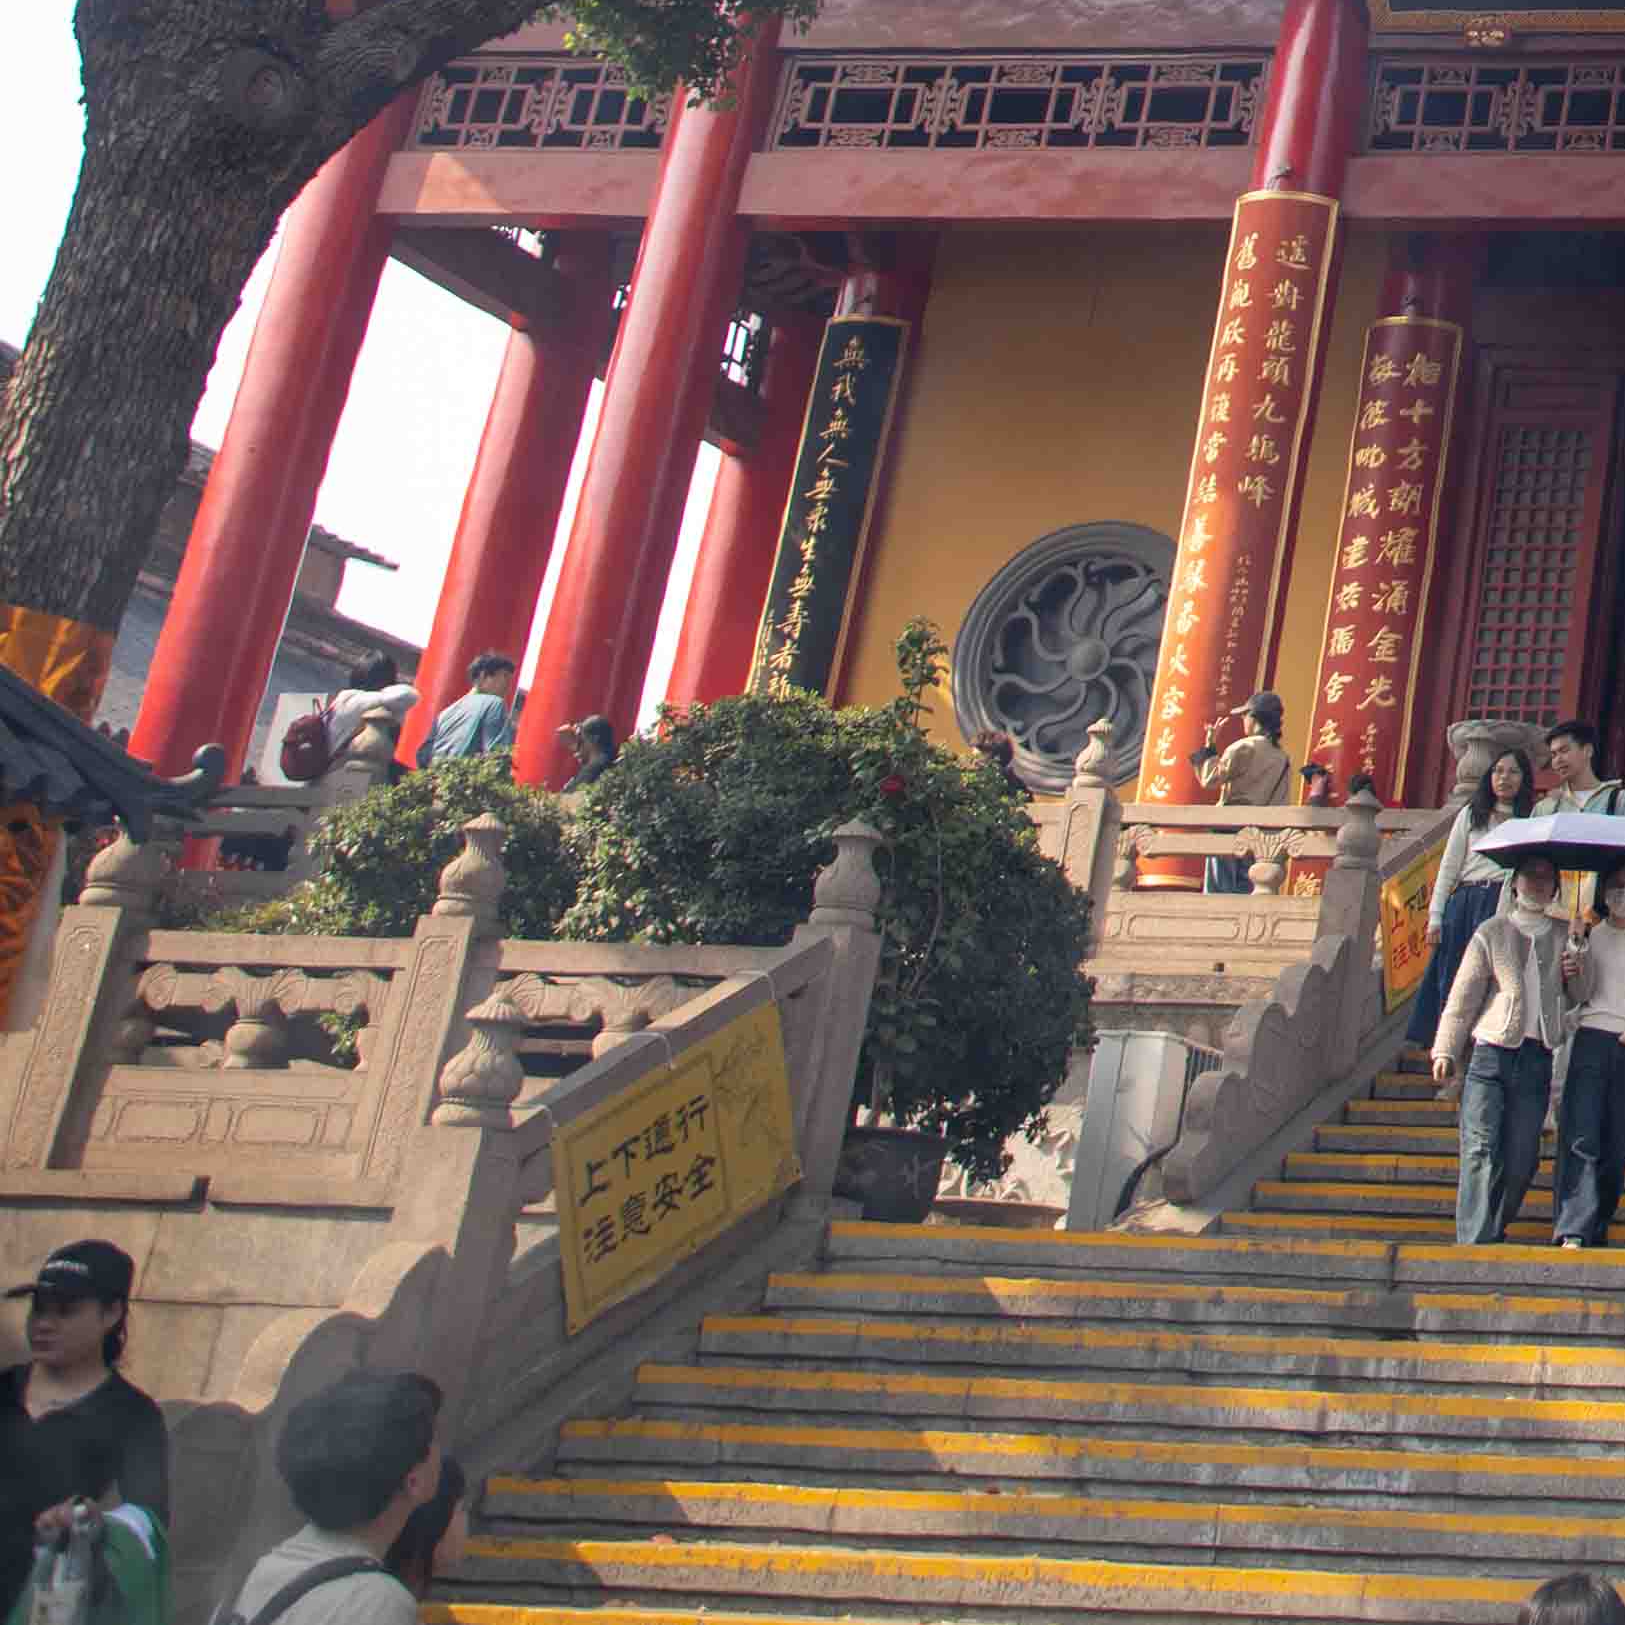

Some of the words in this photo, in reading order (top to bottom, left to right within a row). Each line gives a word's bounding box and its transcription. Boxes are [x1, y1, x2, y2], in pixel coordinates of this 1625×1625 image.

[579, 1094, 710, 1208] 上下通行
[583, 1153, 717, 1264] 注意安全
